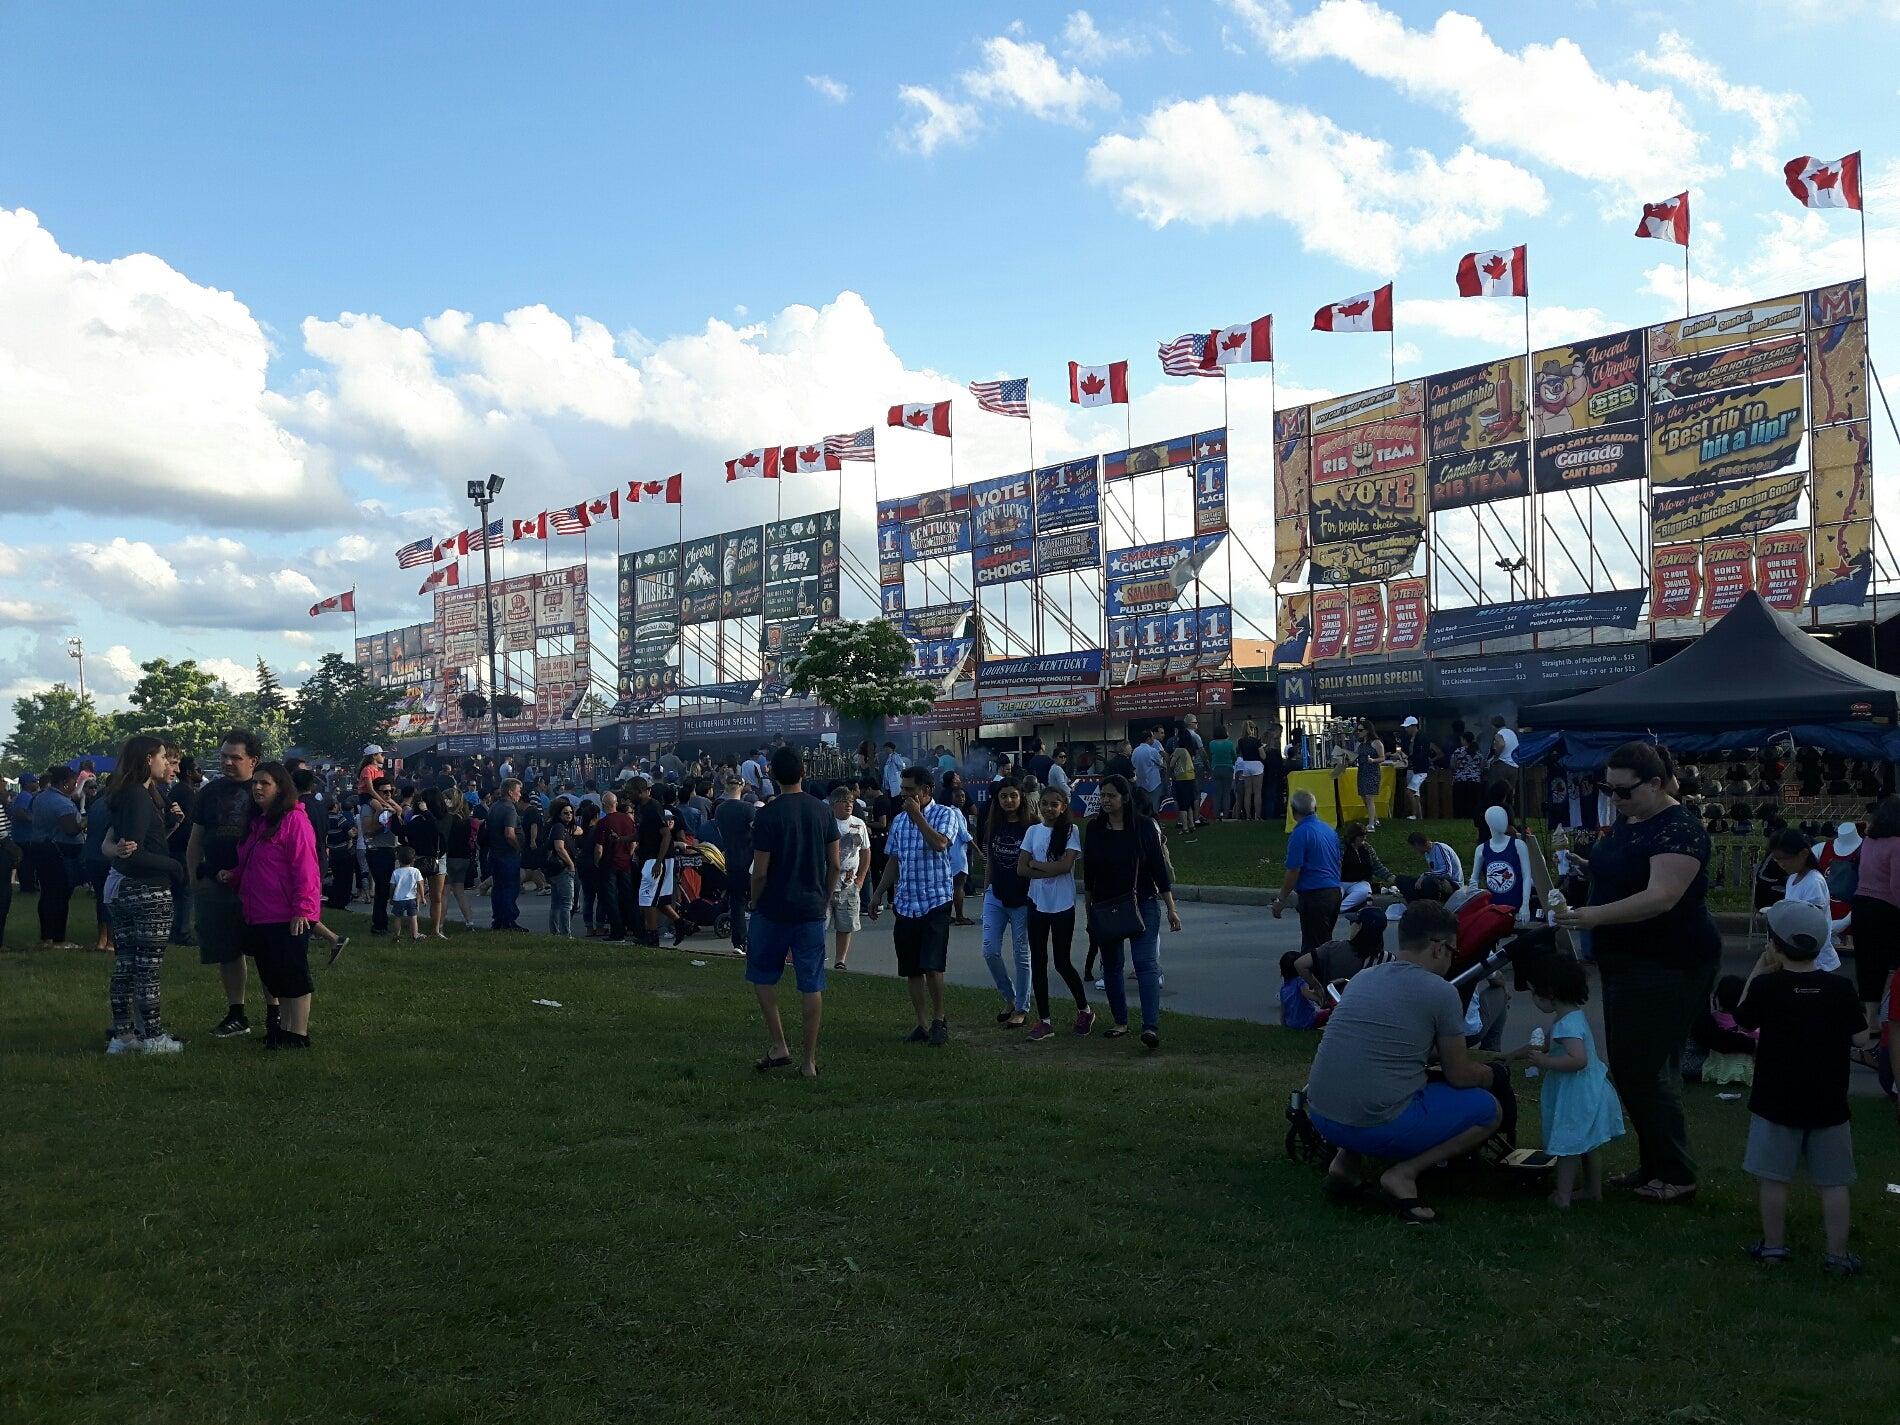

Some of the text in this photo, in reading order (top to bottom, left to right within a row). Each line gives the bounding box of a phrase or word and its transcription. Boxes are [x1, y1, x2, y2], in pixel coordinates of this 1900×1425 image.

[1748, 321, 1768, 334] Hand
[1768, 307, 1801, 325] crafted!
[1586, 334, 1631, 363] Award
[1591, 354, 1641, 384] Winning
[1693, 343, 1800, 384] TRY OUR HOTTEST SAUCE
[1450, 375, 1477, 392] sauce
[1706, 378, 1722, 388] THIS
[1738, 370, 1748, 381] OF
[1749, 367, 1764, 377] THE
[1450, 382, 1495, 411] available
[1595, 389, 1635, 411] BBQ
[1316, 415, 1330, 425] YOU
[1361, 396, 1375, 408] OUR
[1653, 396, 1717, 425] In the news
[1712, 410, 1740, 434] rib
[1745, 403, 1764, 422] to
[1444, 414, 1463, 431] take
[1433, 430, 1460, 450] home!
[1540, 434, 1639, 458] WHO SAYS CANADA
[1701, 433, 1729, 462] hit
[1732, 430, 1747, 450] a
[1322, 444, 1415, 474] RIB TEAM
[1488, 451, 1517, 472] Best
[1557, 444, 1623, 468] Canada
[1589, 463, 1618, 476] BBQ?
[976, 481, 1026, 508] VOTE
[1338, 474, 1414, 509] VOTE
[1434, 469, 1523, 500] RIB TEAM
[1198, 493, 1225, 505] PLACE
[1658, 489, 1717, 513] More news
[1738, 490, 1768, 511] Damn
[976, 503, 1031, 531] KENTUCKY
[1316, 509, 1337, 537] For
[1372, 519, 1400, 530] choice
[910, 521, 962, 542] KENTUCKY
[685, 543, 715, 569] Cheers!
[783, 550, 807, 563] BBQ
[880, 551, 901, 561] PLACE
[993, 545, 1012, 556] FOR
[977, 560, 1031, 583] CHOICE
[1121, 554, 1179, 573] CHICKEN
[1370, 561, 1391, 577] BBQ
[1714, 566, 1742, 575] HONEY
[541, 573, 568, 588] VOTE
[1664, 579, 1690, 588] SMOKED
[1768, 569, 1798, 580] WILL
[1768, 580, 1787, 588] MELT
[637, 579, 675, 606] WHISKEY
[1664, 588, 1691, 597] PORK
[1716, 584, 1744, 592] MAPLE
[1119, 602, 1154, 614] PULLED
[1397, 611, 1418, 621] WILL
[1476, 598, 1589, 616] MUSTANG MENU
[1138, 646, 1165, 656] PLACE
[1168, 642, 1195, 652] PLACE
[1201, 638, 1229, 648] PLACE
[929, 667, 951, 675] PLACE
[981, 657, 1090, 677] LOUISVILLE KENTUCKY
[1541, 660, 1566, 668] Straight
[1582, 656, 1602, 664] Pulled
[1285, 679, 1305, 699] M
[1319, 670, 1424, 690] SALLY SALOON SPECIAL
[997, 697, 1078, 712] THE NEW YORKER
[684, 720, 695, 729] THE
[733, 716, 757, 726] SPECIAL
